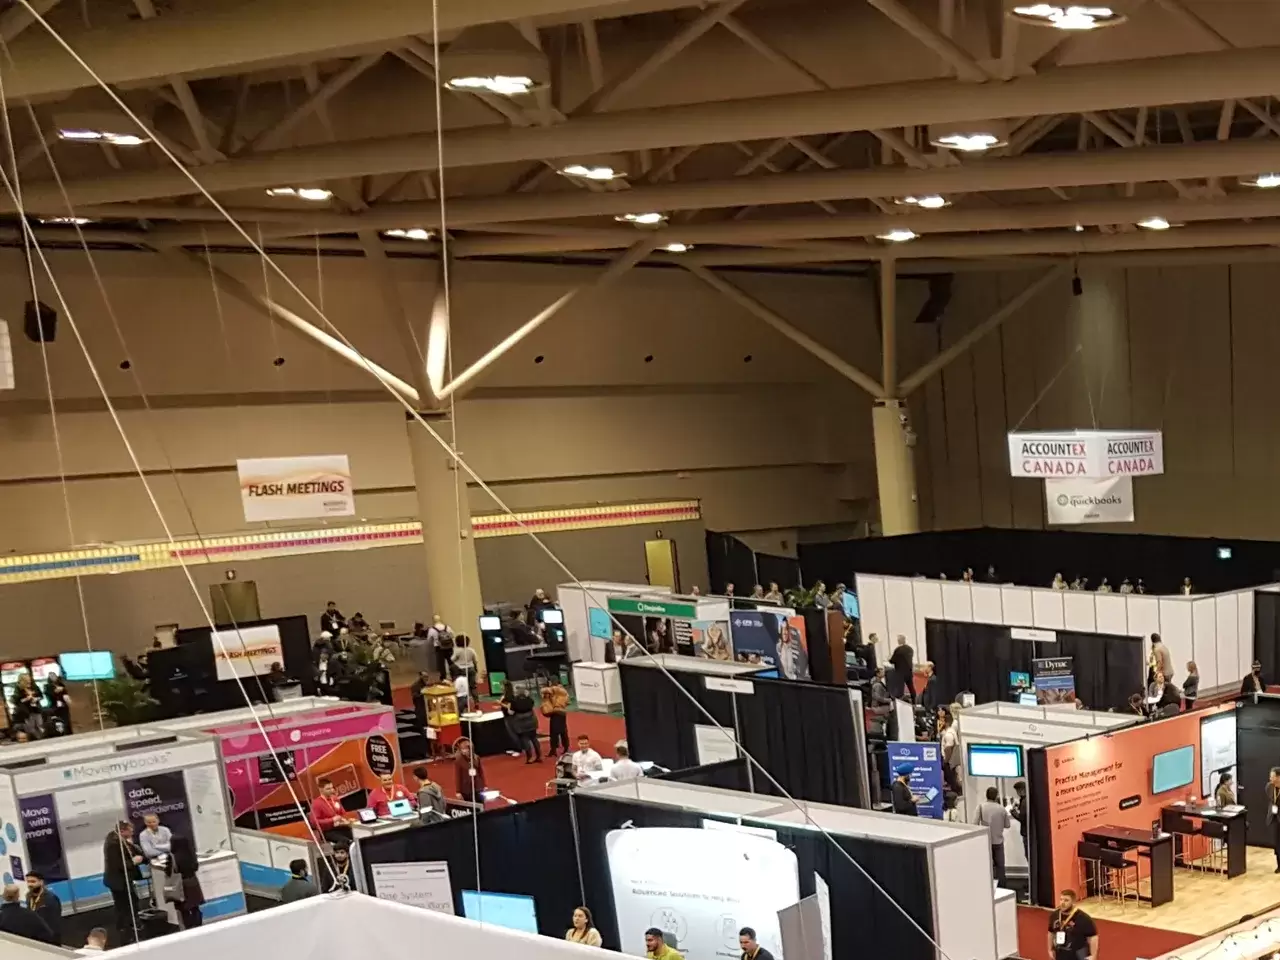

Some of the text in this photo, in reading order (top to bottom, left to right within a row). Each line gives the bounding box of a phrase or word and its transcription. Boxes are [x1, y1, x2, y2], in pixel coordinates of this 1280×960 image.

[1022, 442, 1086, 456] ACCOUNTEX
[1107, 440, 1155, 455] ACCOUNTEX
[1022, 460, 1087, 475] CANADA
[1108, 458, 1155, 474] CANADA
[248, 480, 345, 497] FLASH MEETINGS
[1069, 495, 1122, 507] quickbooks
[370, 744, 387, 754] FREE
[21, 806, 49, 818] Move
[29, 817, 51, 828] with
[25, 828, 53, 839] more
